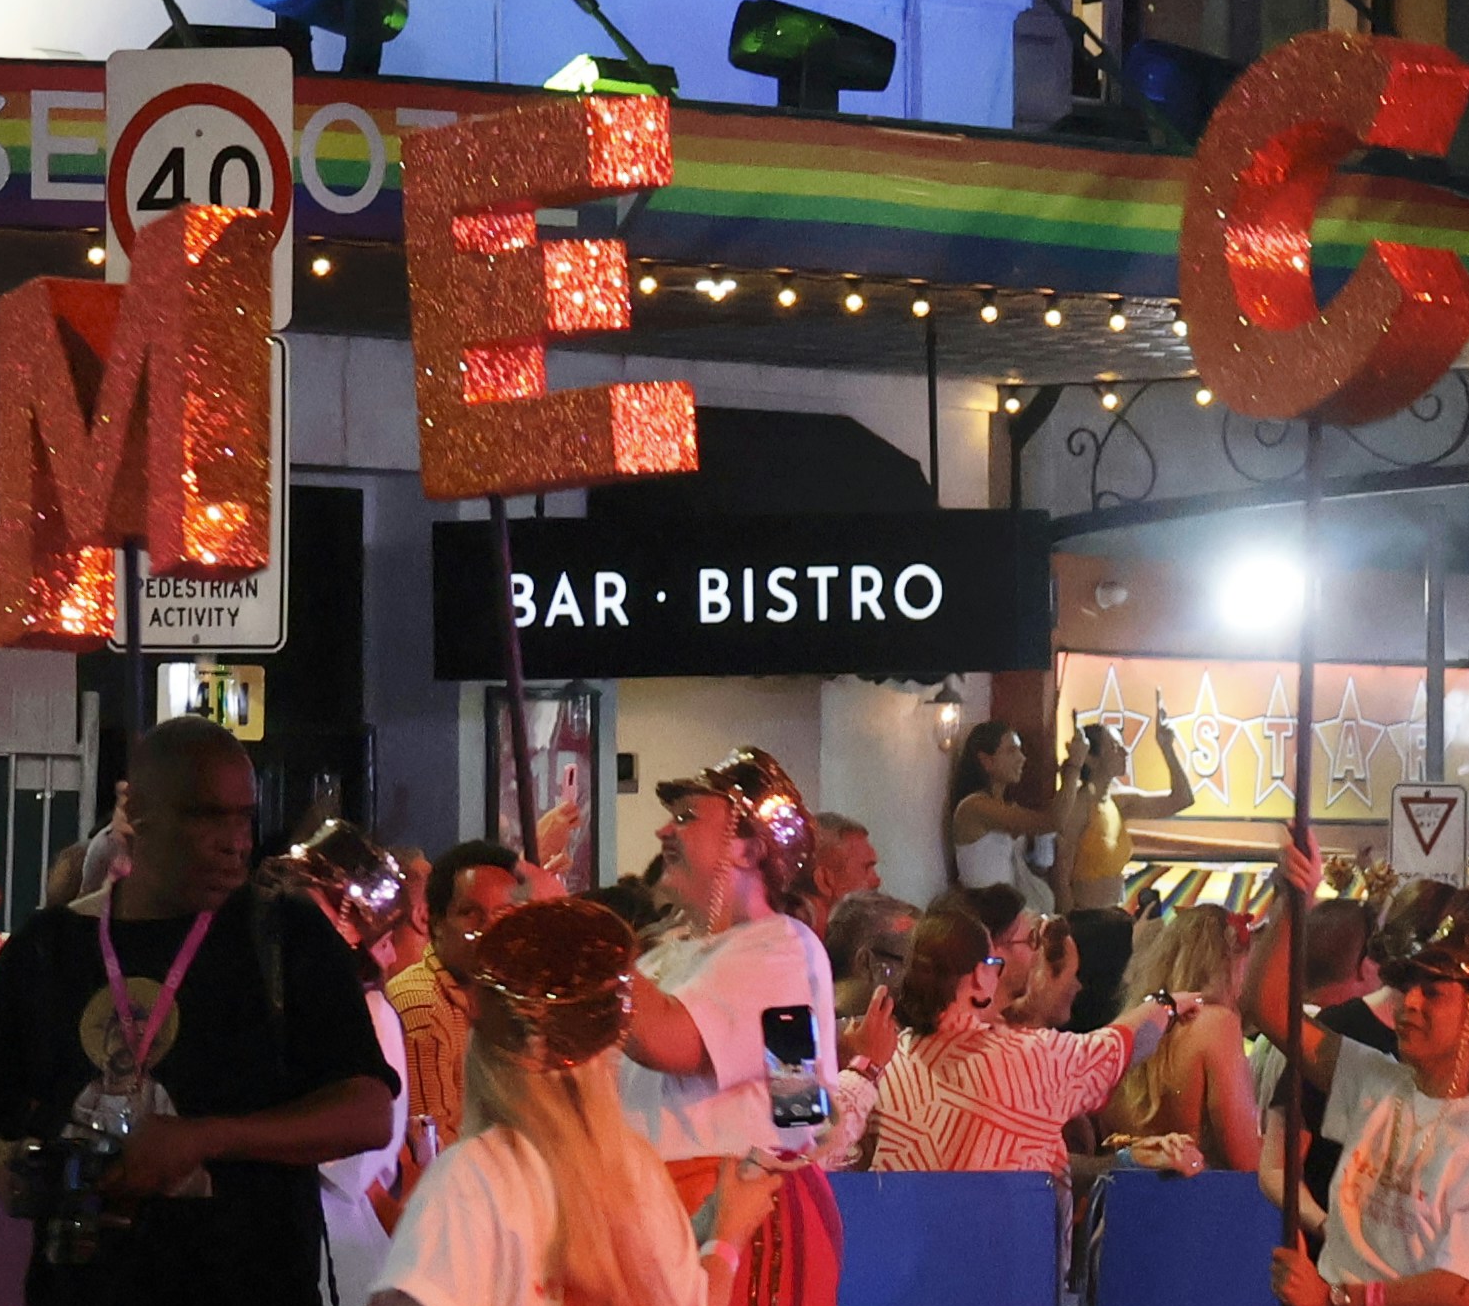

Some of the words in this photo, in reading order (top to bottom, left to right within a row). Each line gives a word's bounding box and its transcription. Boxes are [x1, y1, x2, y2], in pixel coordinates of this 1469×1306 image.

[137, 145, 262, 212] 40
[149, 607, 240, 627] ACTIVITY
[512, 571, 629, 628] BAR
[700, 563, 945, 626] BISTRO
